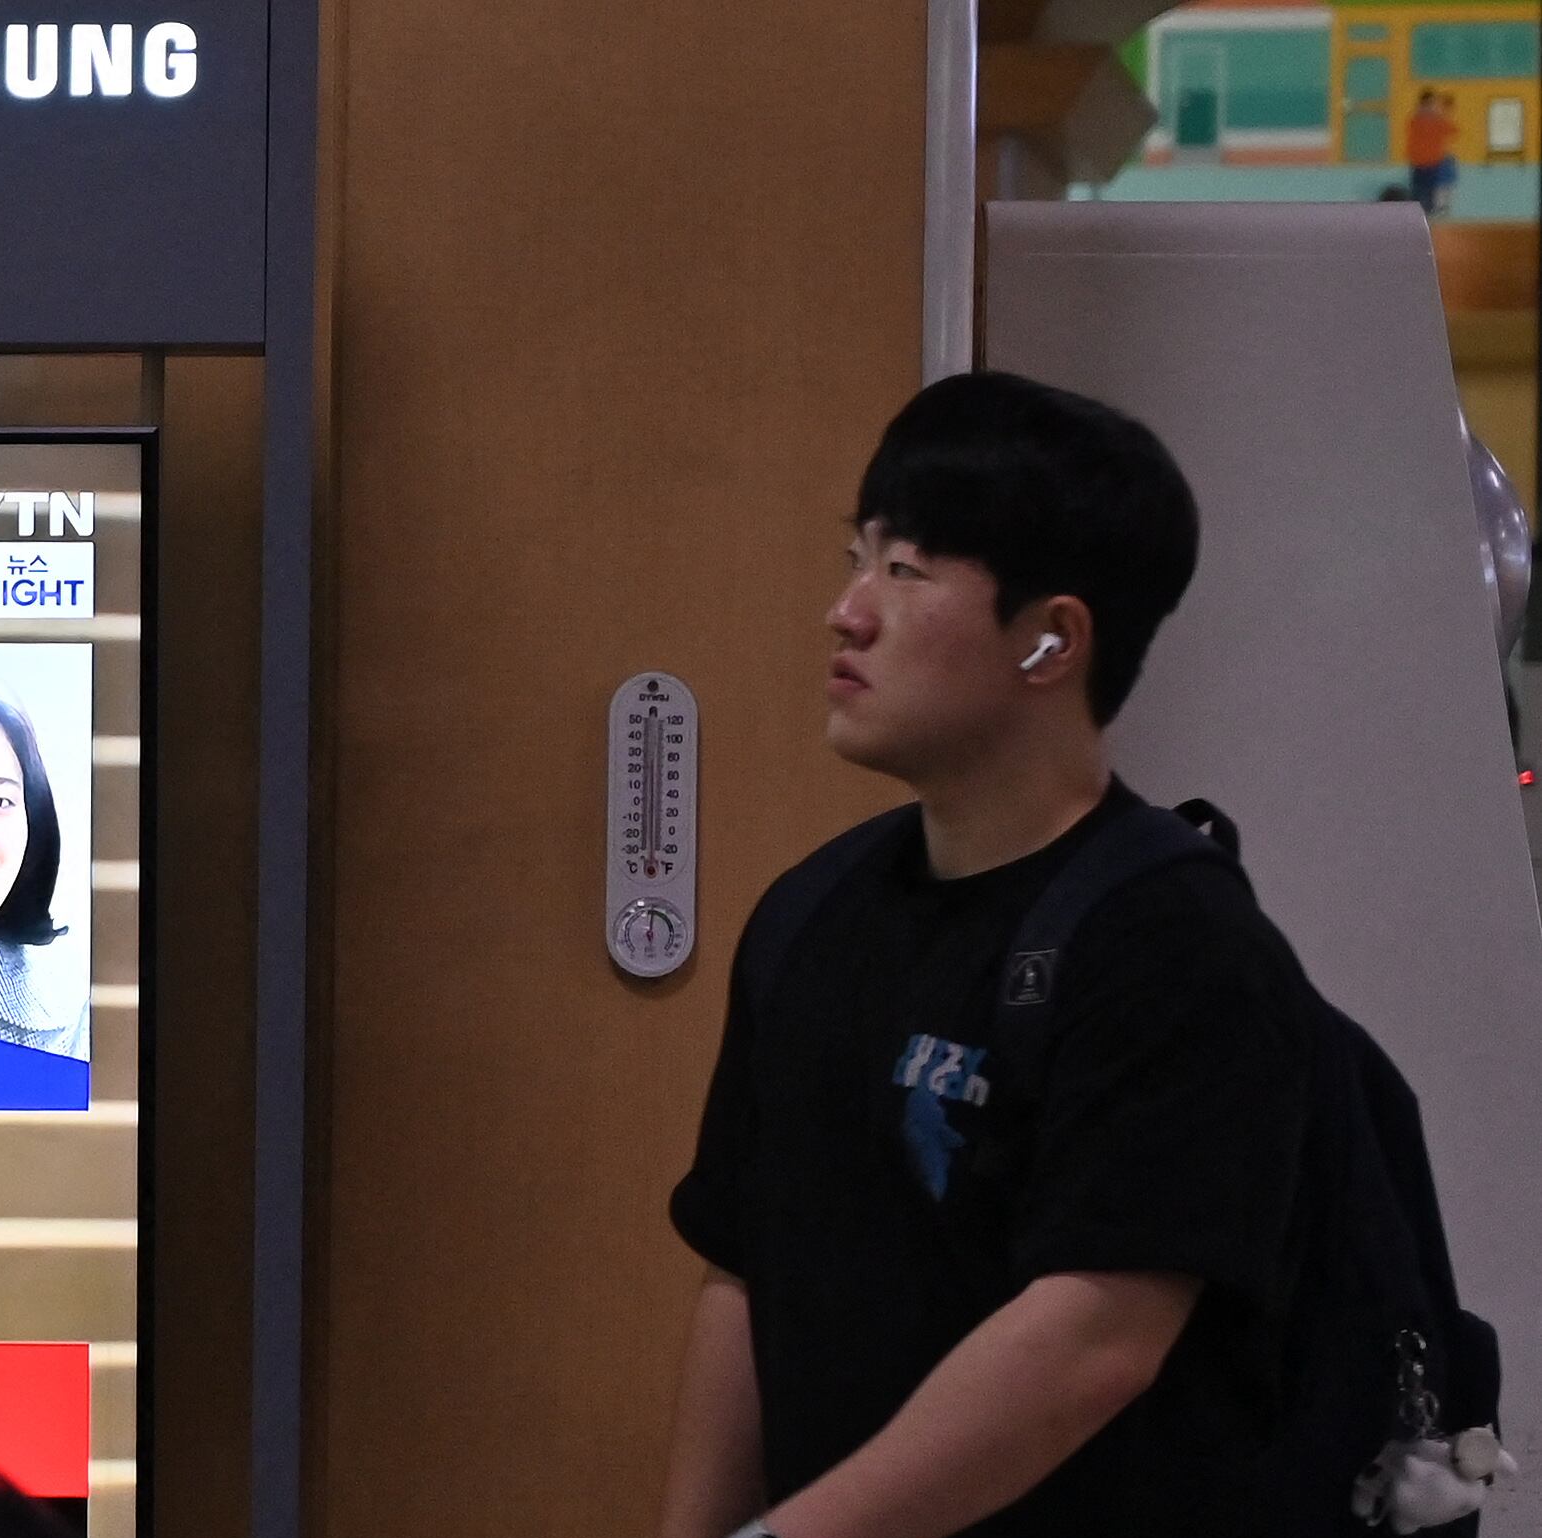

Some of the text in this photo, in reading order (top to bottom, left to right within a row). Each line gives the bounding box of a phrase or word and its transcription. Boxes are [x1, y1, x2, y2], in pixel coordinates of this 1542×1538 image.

[6, 555, 49, 576] 뉴스
[628, 714, 642, 725] 50
[666, 715, 684, 725] 120
[628, 730, 642, 741] 40
[666, 734, 683, 744] 100
[628, 747, 642, 757] 30
[627, 763, 641, 773] 20
[629, 780, 641, 790] 10
[666, 789, 679, 799] 40
[633, 796, 641, 806] 0
[666, 807, 679, 818] 20
[668, 826, 676, 836] 0
